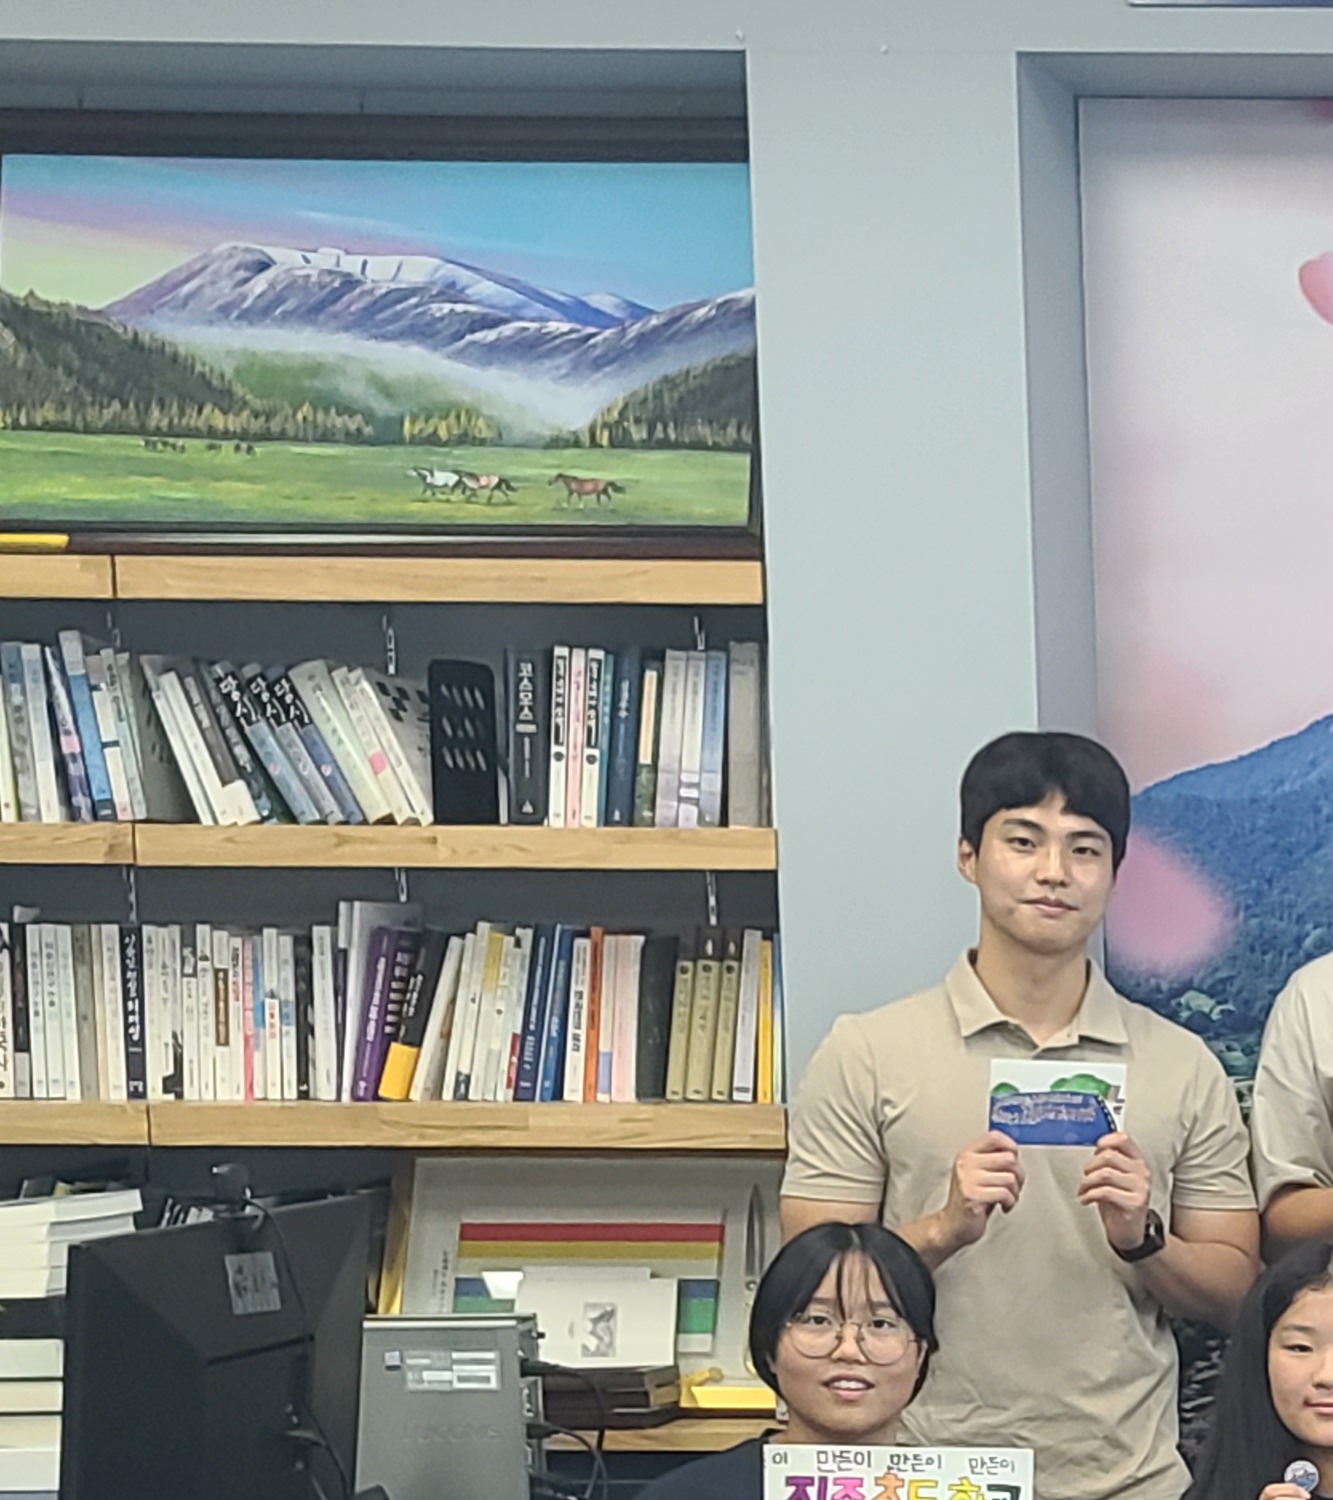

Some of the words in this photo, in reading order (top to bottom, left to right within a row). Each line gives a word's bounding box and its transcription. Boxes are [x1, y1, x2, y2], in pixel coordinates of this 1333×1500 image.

[518, 661, 534, 721] 코스모스
[816, 1450, 872, 1473] 만든이
[889, 1453, 943, 1473] 만든이
[967, 1456, 1016, 1476] 만든이
